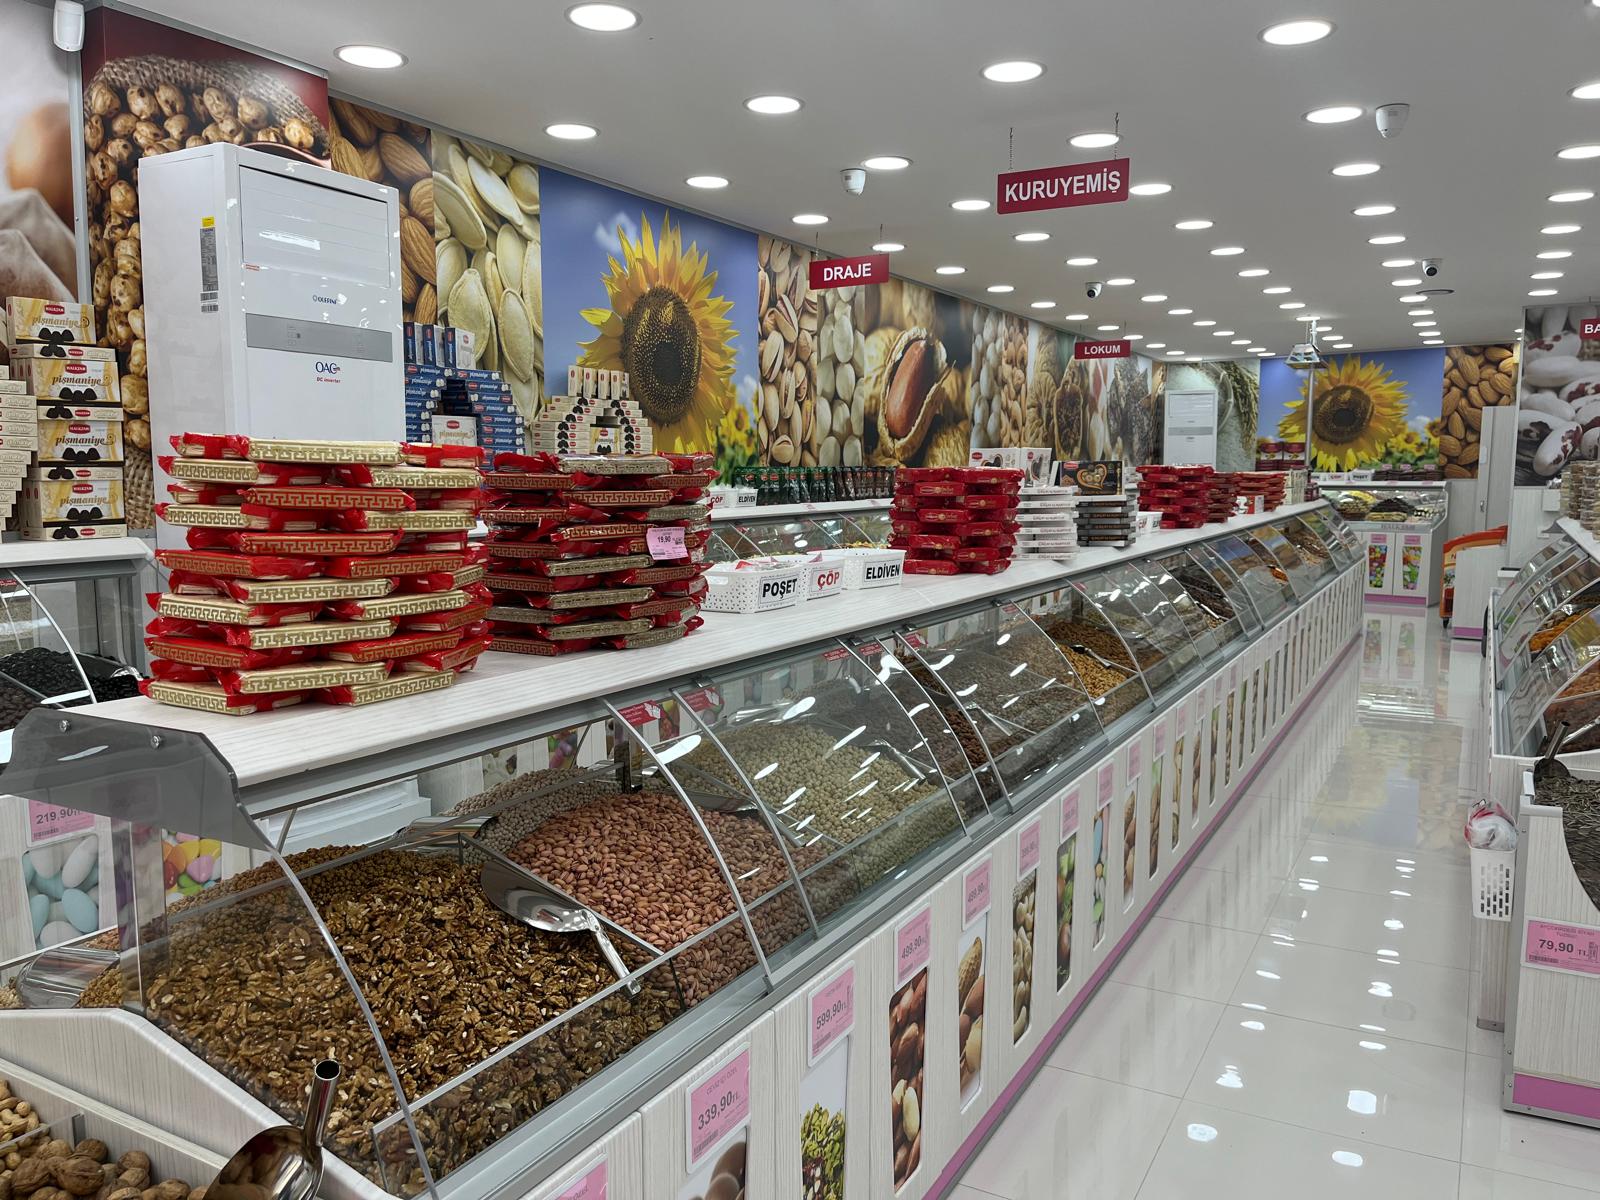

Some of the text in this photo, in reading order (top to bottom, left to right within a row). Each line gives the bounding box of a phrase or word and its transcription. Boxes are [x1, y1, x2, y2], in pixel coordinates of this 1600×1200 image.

[1005, 168, 1120, 203] KURUYEMİŞ
[823, 263, 872, 282] DRAJE
[1084, 344, 1121, 355] LOKUM
[817, 569, 840, 591] ÇÖP
[865, 562, 901, 580] ELDİVEN
[762, 578, 798, 600] POŞET
[1538, 939, 1574, 953] 79,90
